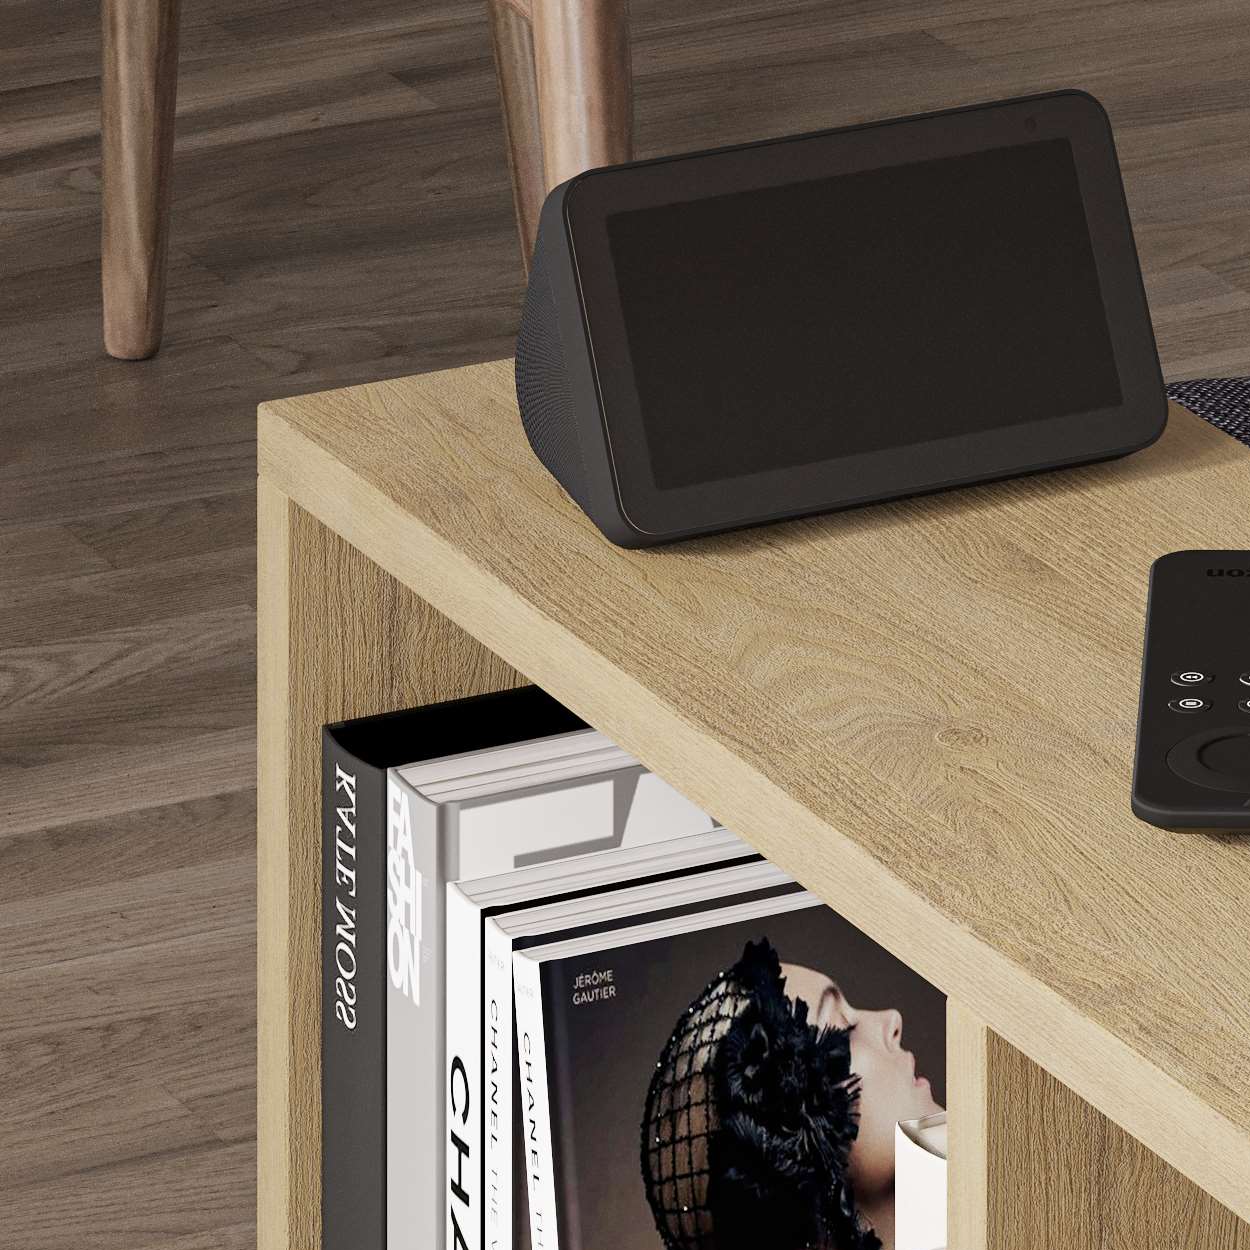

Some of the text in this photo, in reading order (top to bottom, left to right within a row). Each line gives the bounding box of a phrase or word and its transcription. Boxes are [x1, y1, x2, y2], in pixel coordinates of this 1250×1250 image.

[572, 985, 617, 1005] GAUTIER
[489, 998, 499, 1152] CHANEL
[523, 1032, 541, 1192] CHANEL
